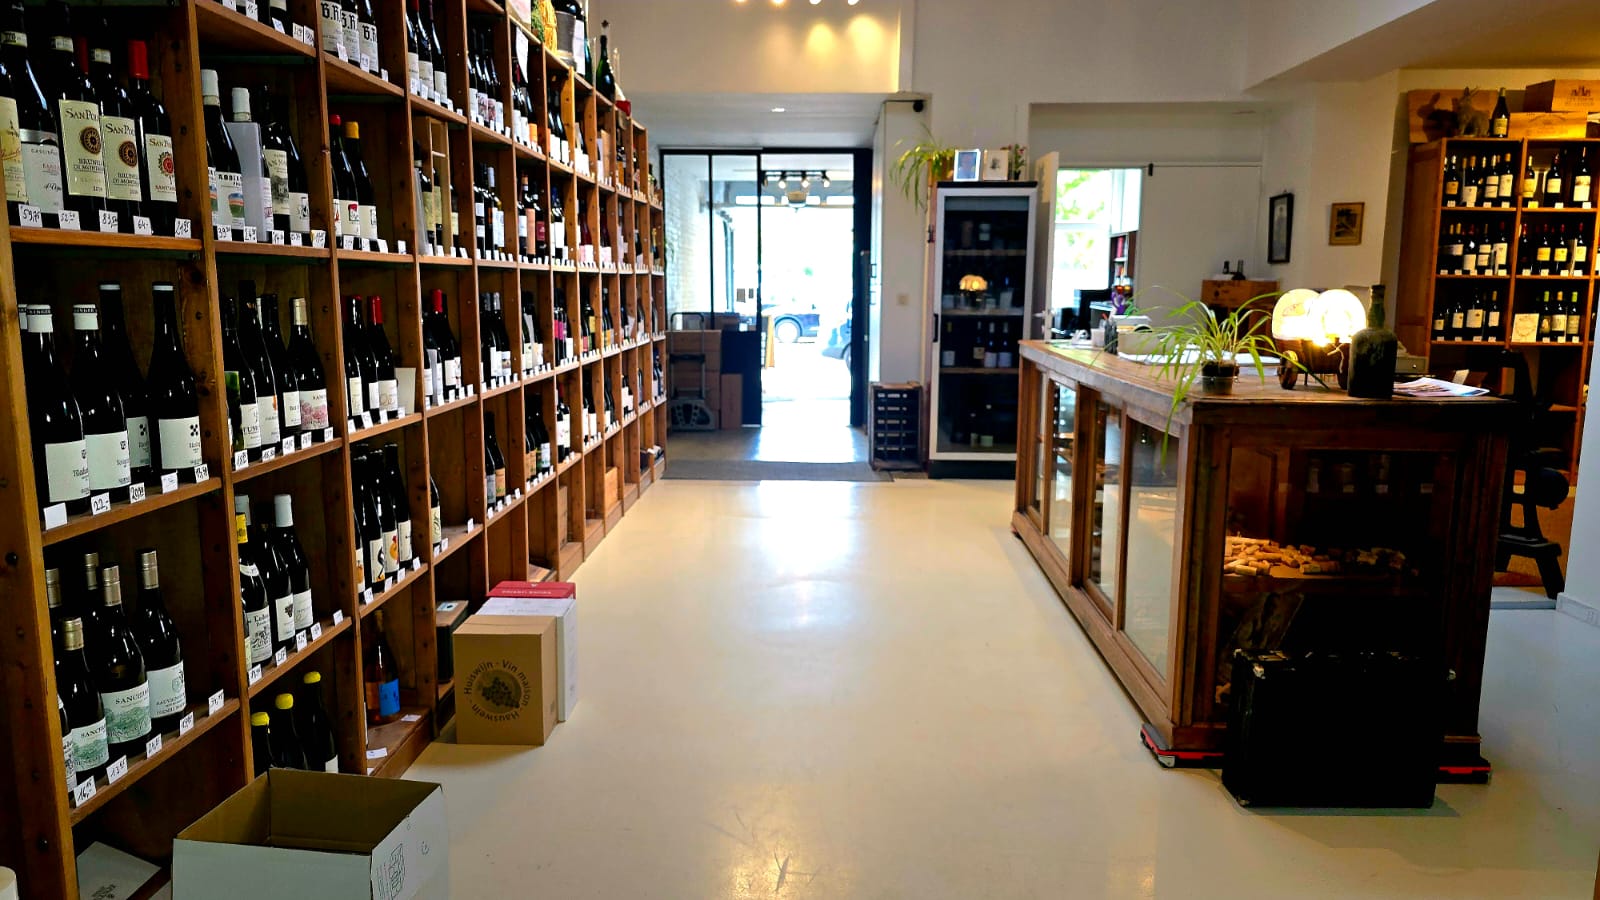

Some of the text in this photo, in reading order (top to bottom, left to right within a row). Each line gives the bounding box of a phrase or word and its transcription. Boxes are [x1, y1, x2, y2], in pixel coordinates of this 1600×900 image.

[464, 661, 494, 694] Huiswijn
[502, 659, 519, 673] Vin
[518, 672, 532, 706] maison
